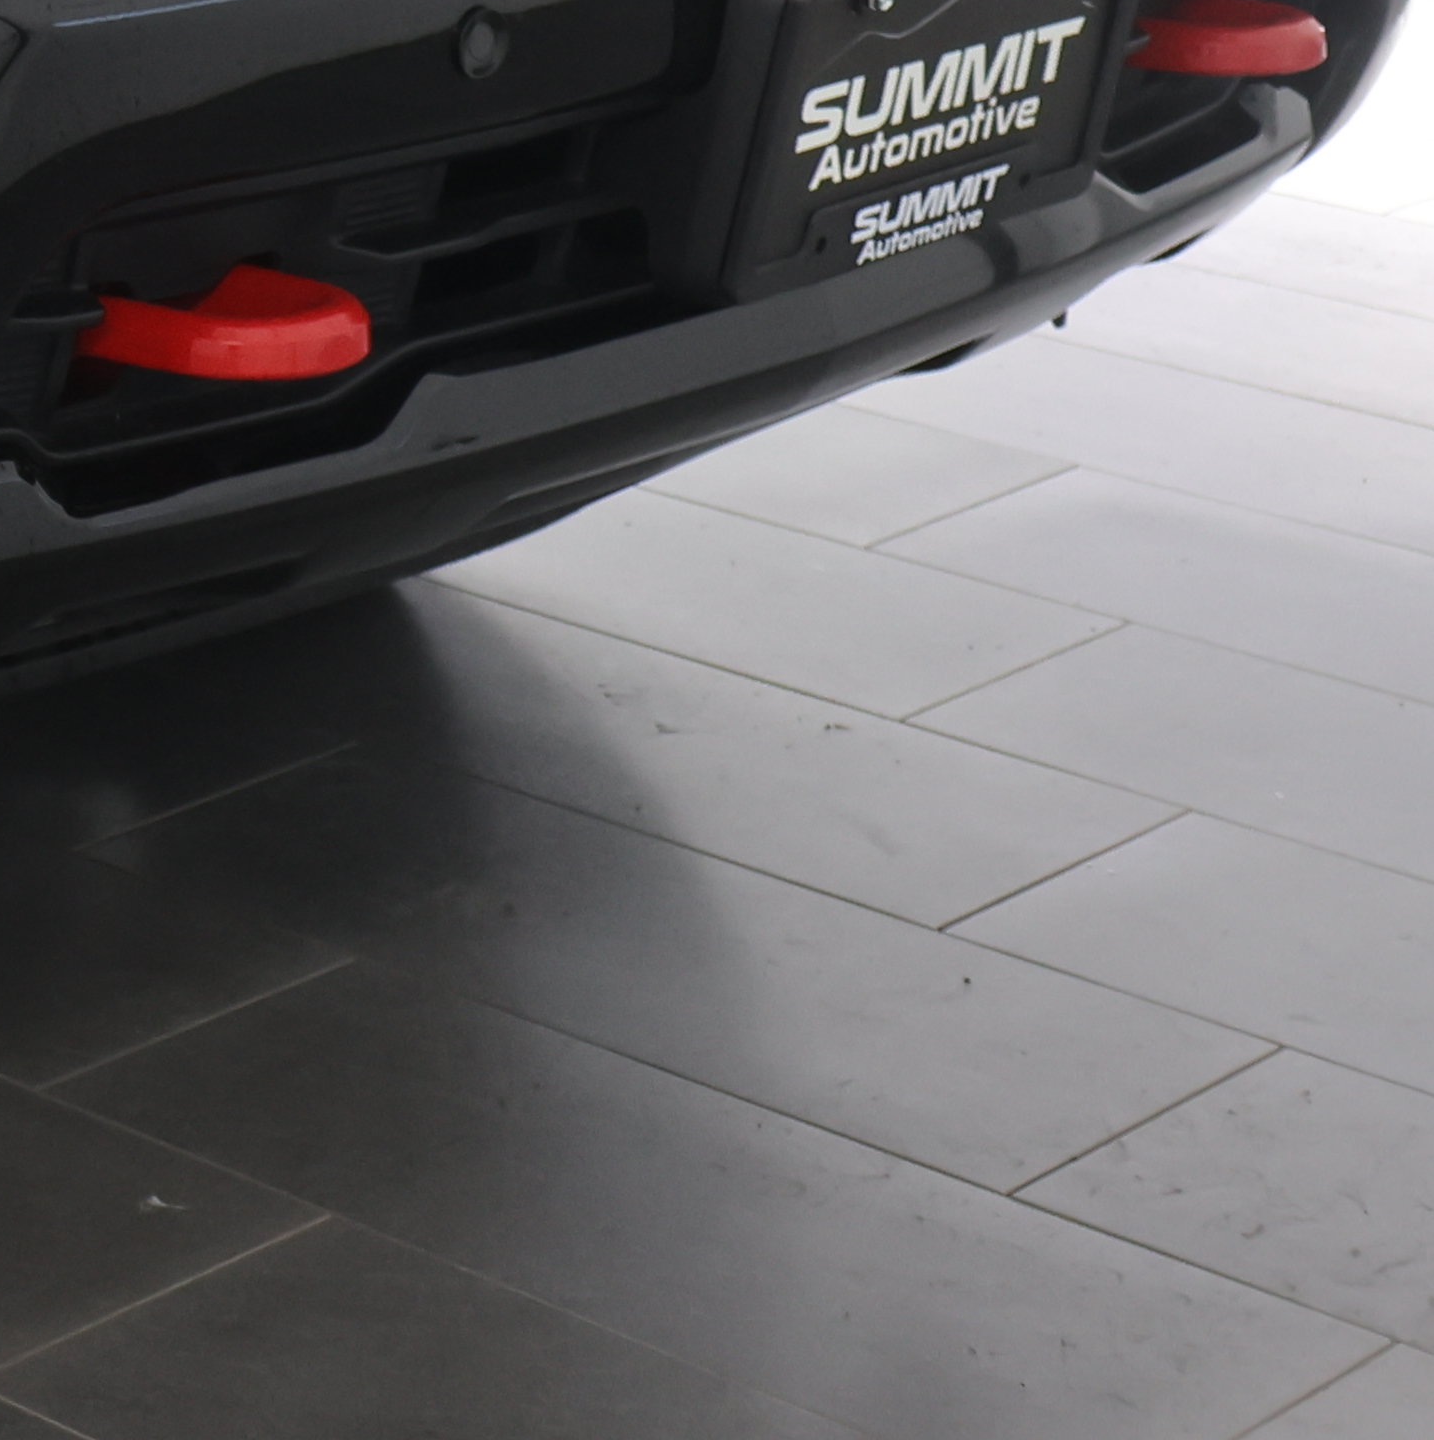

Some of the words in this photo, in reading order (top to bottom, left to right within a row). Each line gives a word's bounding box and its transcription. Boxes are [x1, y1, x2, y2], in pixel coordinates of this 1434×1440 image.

[795, 16, 1087, 154] SUMMIT
[808, 94, 1040, 191] Automotive
[850, 163, 1010, 245] SUMMIT
[856, 209, 984, 266] Automotive
